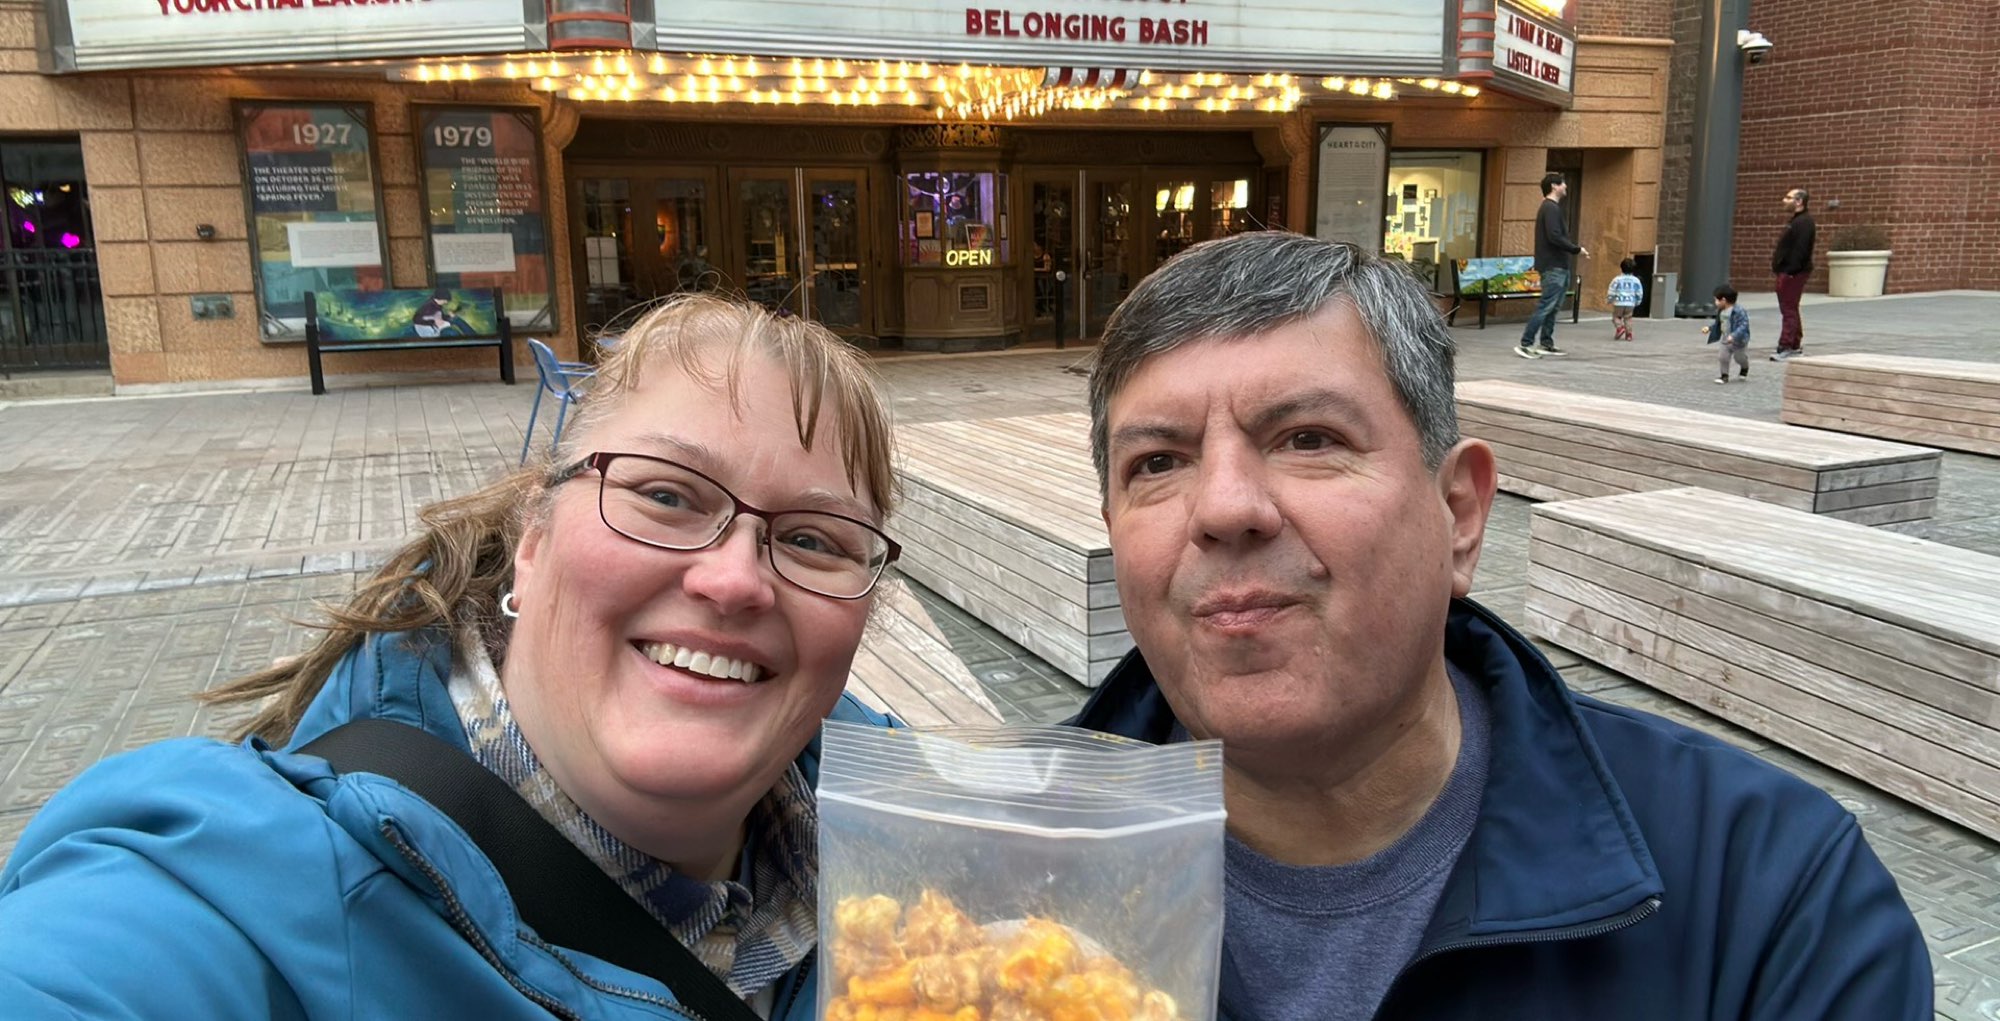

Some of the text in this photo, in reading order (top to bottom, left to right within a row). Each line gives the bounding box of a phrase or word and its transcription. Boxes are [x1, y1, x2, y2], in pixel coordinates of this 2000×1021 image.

[966, 8, 1208, 45] BELONGING BASH
[1508, 14, 1513, 35] A
[293, 123, 352, 145] 1927
[434, 126, 492, 147] 1979
[1327, 141, 1353, 149] HEART
[1361, 141, 1377, 149] CITY
[461, 157, 476, 165] THE
[254, 166, 345, 174] THE THEATER OPENED
[255, 175, 268, 184] ON
[269, 175, 309, 184] OCTOBER
[256, 184, 349, 193] FEATURING THE MOVIE
[946, 249, 992, 266] OPEN
